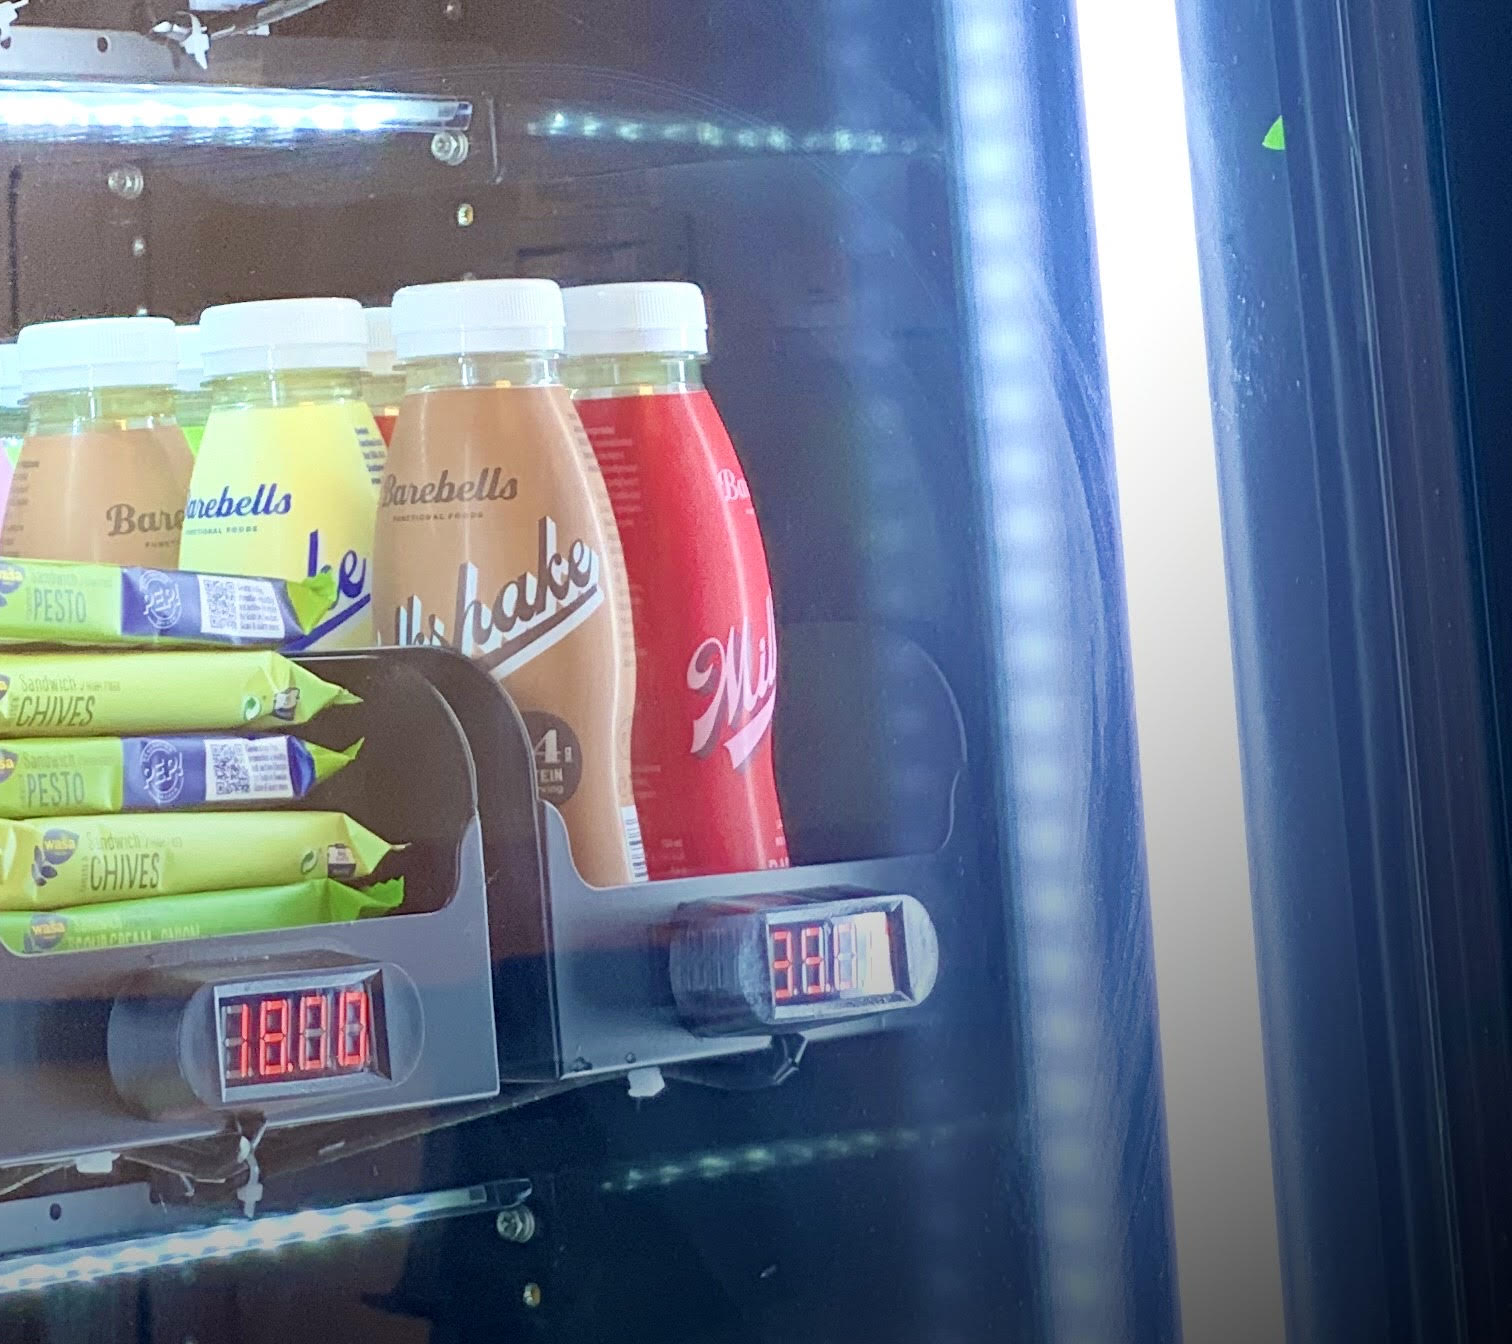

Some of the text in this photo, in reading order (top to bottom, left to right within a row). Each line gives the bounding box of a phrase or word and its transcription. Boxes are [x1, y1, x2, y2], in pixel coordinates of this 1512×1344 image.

[185, 483, 293, 520] arebells
[33, 587, 87, 624] PESTO
[16, 695, 96, 728] CHIVES
[27, 771, 86, 808] PESTO
[43, 835, 76, 851] wasa
[89, 852, 161, 891] CHIVES
[30, 921, 66, 937] wasa
[236, 989, 369, 1078] 18.00
